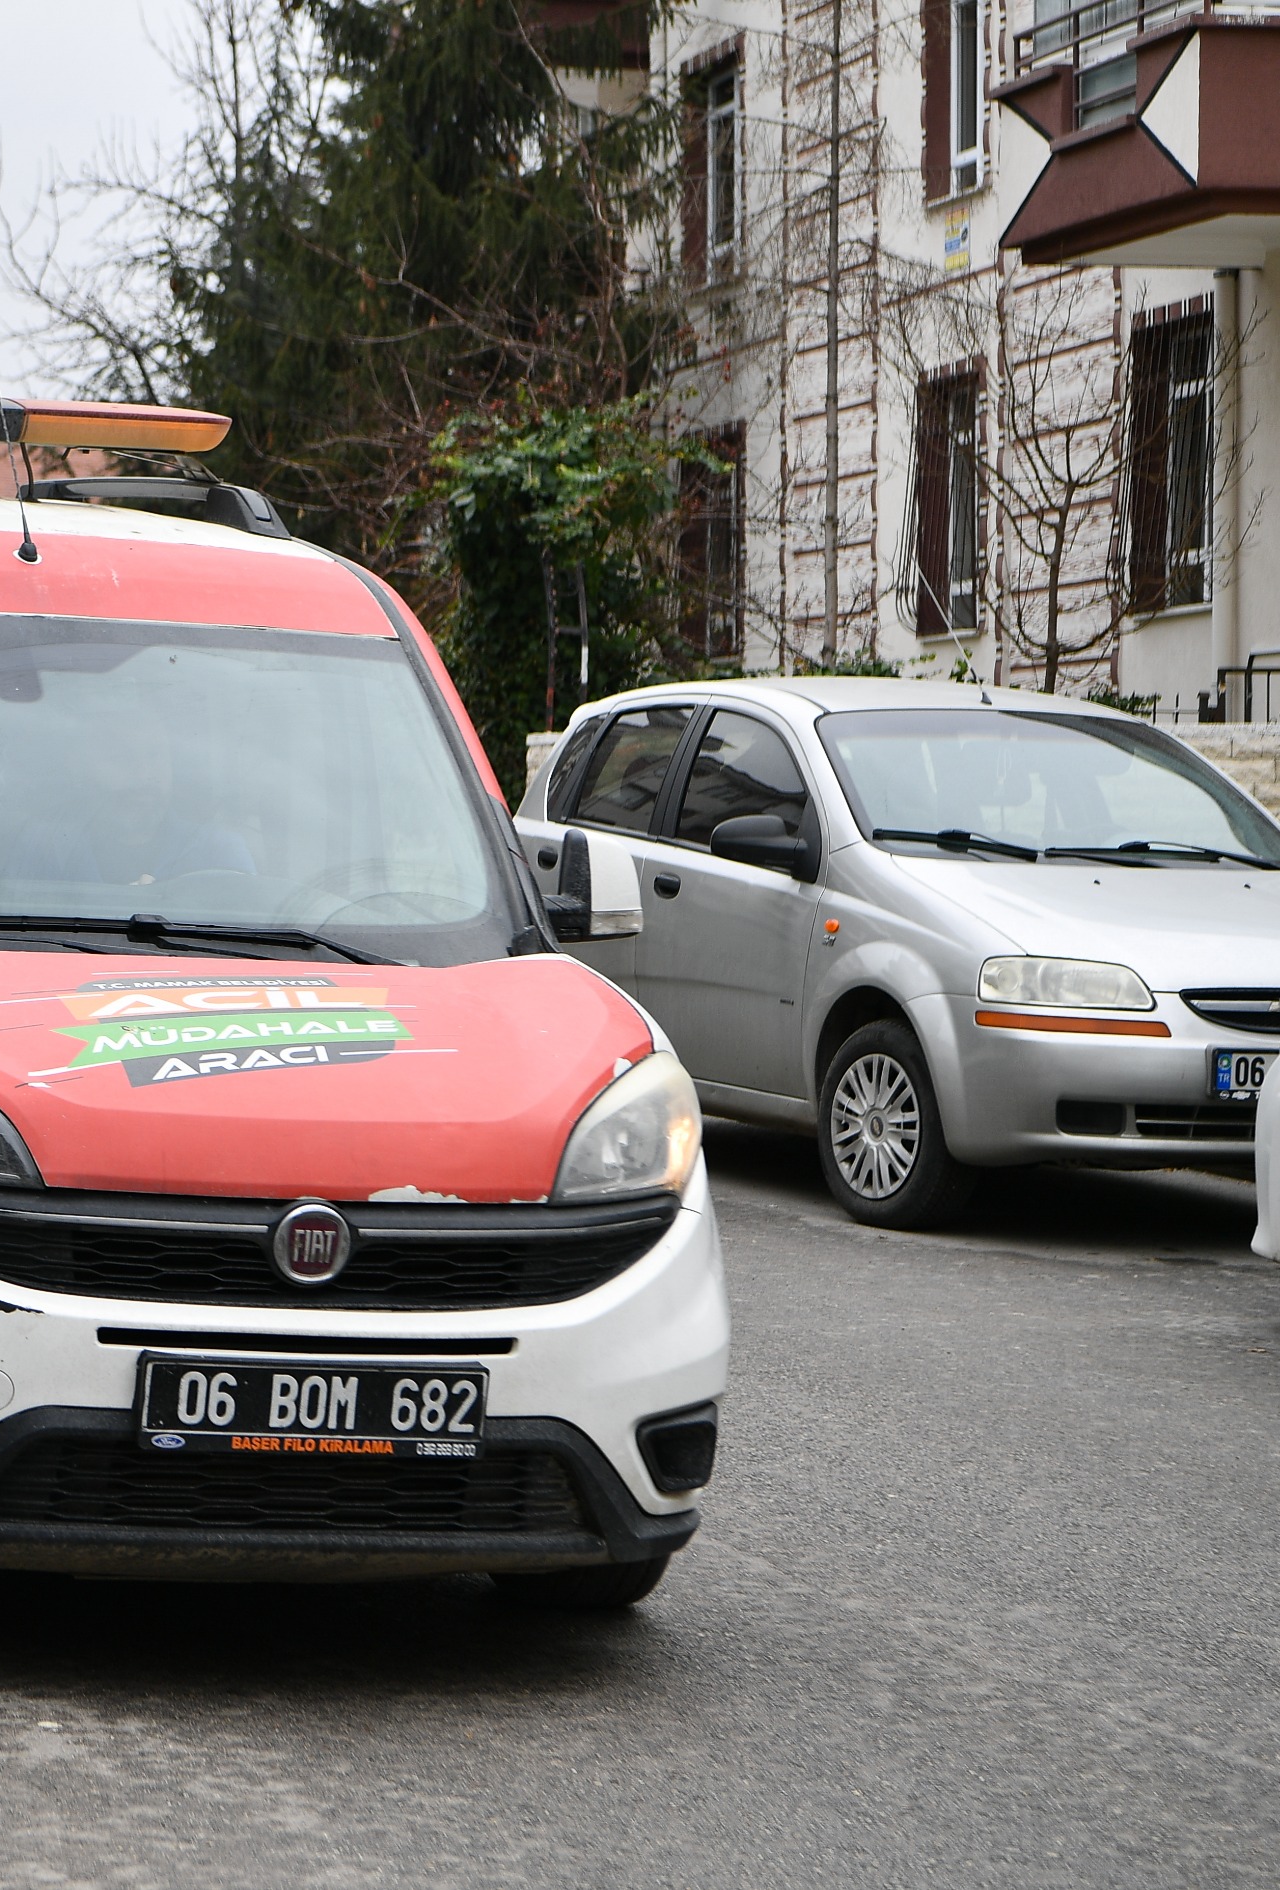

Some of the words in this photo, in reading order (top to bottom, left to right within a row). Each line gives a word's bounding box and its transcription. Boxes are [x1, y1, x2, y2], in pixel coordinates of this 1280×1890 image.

[89, 987, 365, 1017] ACİL
[93, 982, 131, 990] T.C.
[134, 980, 215, 988] MAMAK
[92, 1019, 400, 1053] MÜDAHALE
[152, 1045, 330, 1081] ARACI
[1219, 1072, 1230, 1083] TR
[293, 1228, 337, 1264] FIAT
[177, 1371, 238, 1426] 06
[269, 1374, 359, 1430] BOM
[390, 1378, 478, 1433] 682
